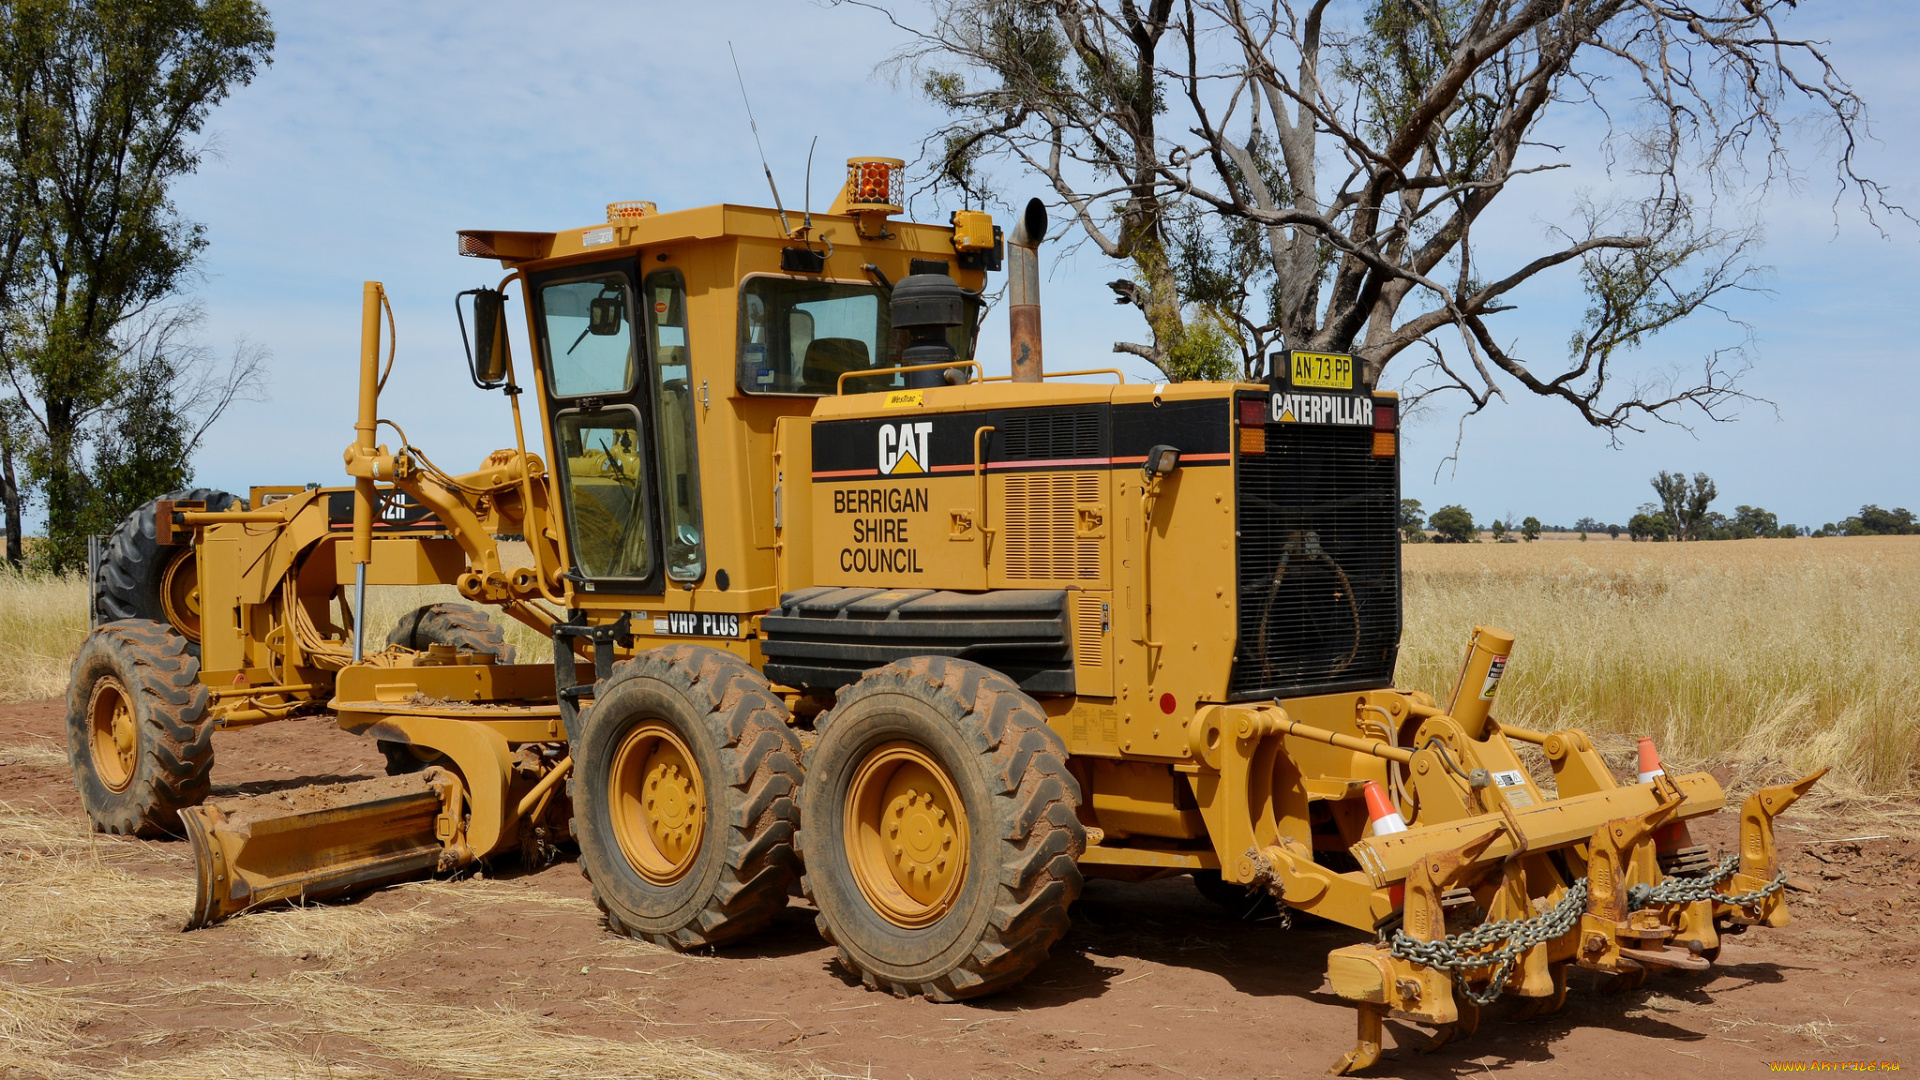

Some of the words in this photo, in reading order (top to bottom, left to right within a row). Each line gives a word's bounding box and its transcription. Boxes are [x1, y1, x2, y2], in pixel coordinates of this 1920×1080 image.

[1272, 393, 1373, 425] CATERPILLAR
[878, 422, 933, 475] CAT
[834, 488, 928, 513] BERRIGAN
[853, 518, 908, 543] SHIRE
[840, 548, 923, 573] COUNCIL
[669, 613, 698, 634] VHP
[702, 614, 738, 637] PLUS
